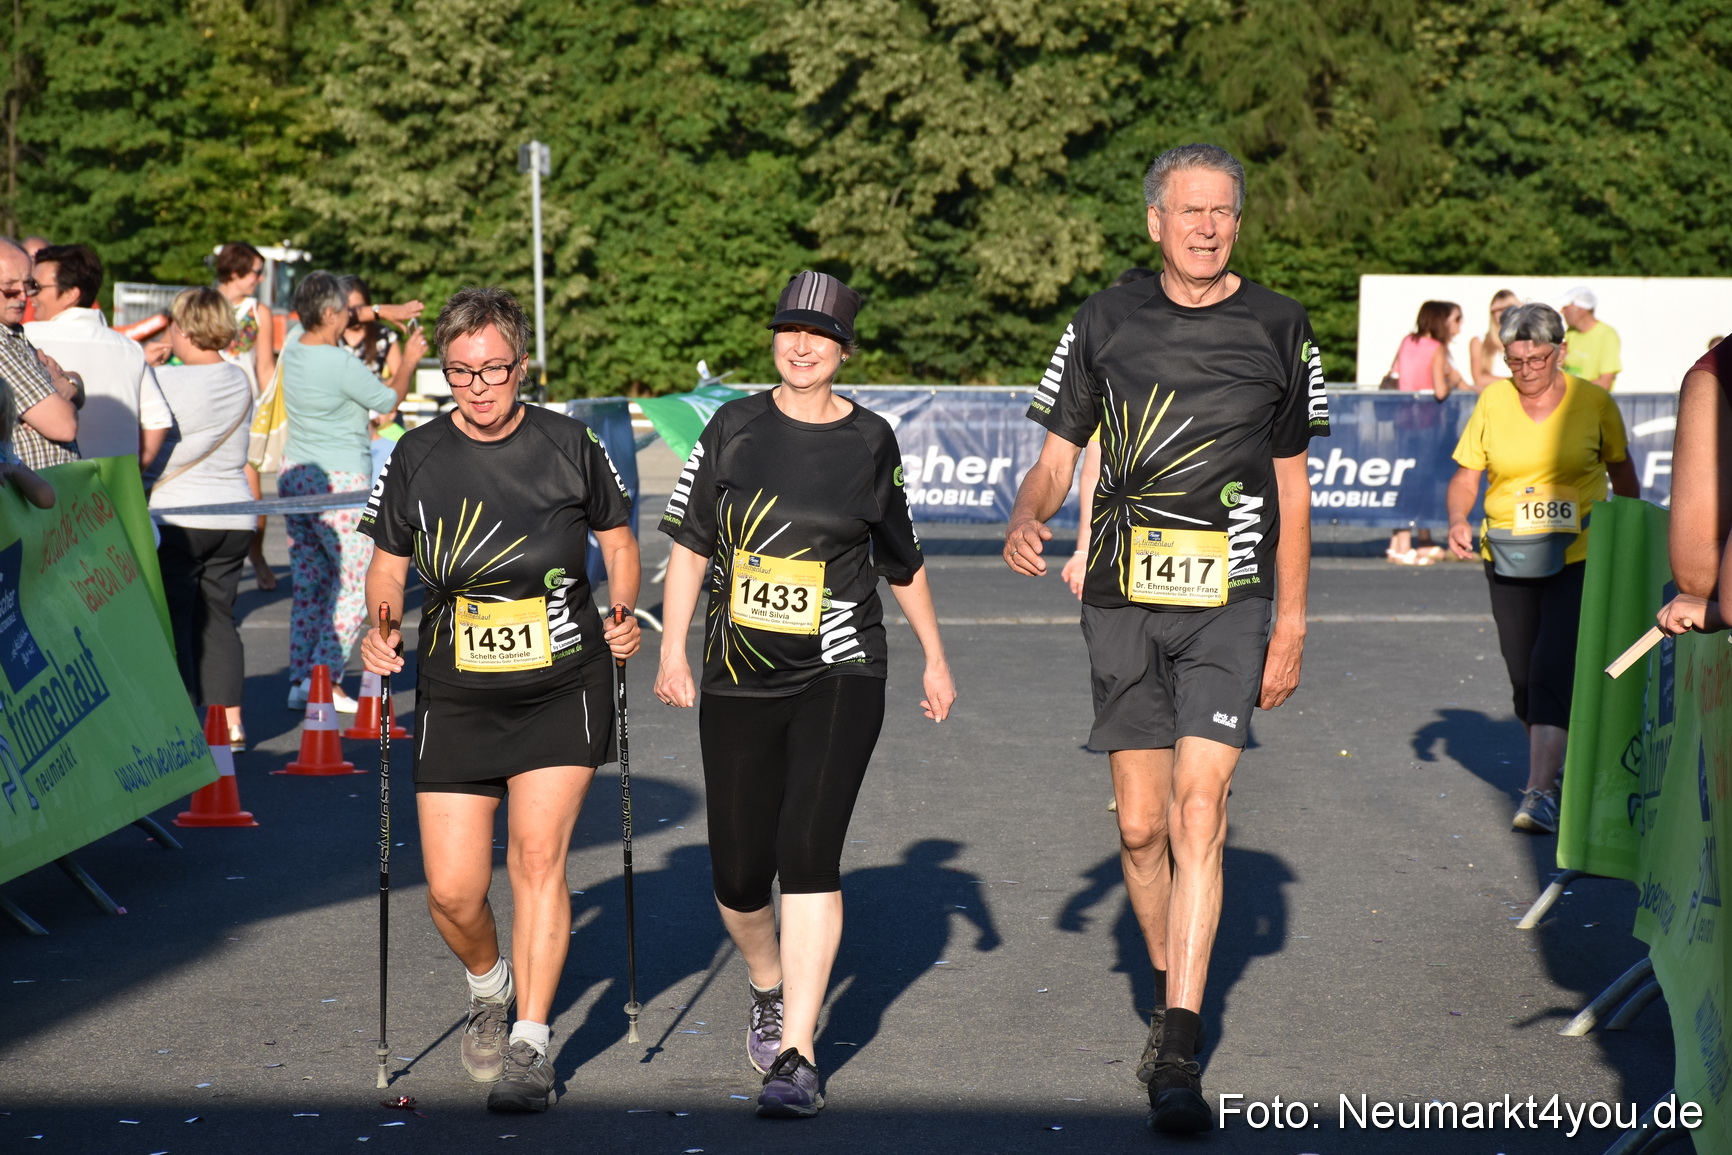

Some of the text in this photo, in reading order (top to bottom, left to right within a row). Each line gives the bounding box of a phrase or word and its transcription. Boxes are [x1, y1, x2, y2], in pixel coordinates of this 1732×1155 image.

[1521, 502, 1572, 520] 1686
[1140, 555, 1215, 585] 1417
[740, 578, 808, 613] 1433
[1148, 582, 1195, 594] Ehrnsperger
[1197, 585, 1219, 594] Franz
[751, 607, 790, 620] Wittl Silvia
[463, 624, 532, 652] 1431
[470, 651, 531, 660] Schelte Gabriele
[1, 626, 109, 765] firmenlauf
[35, 741, 78, 797] neumarkt
